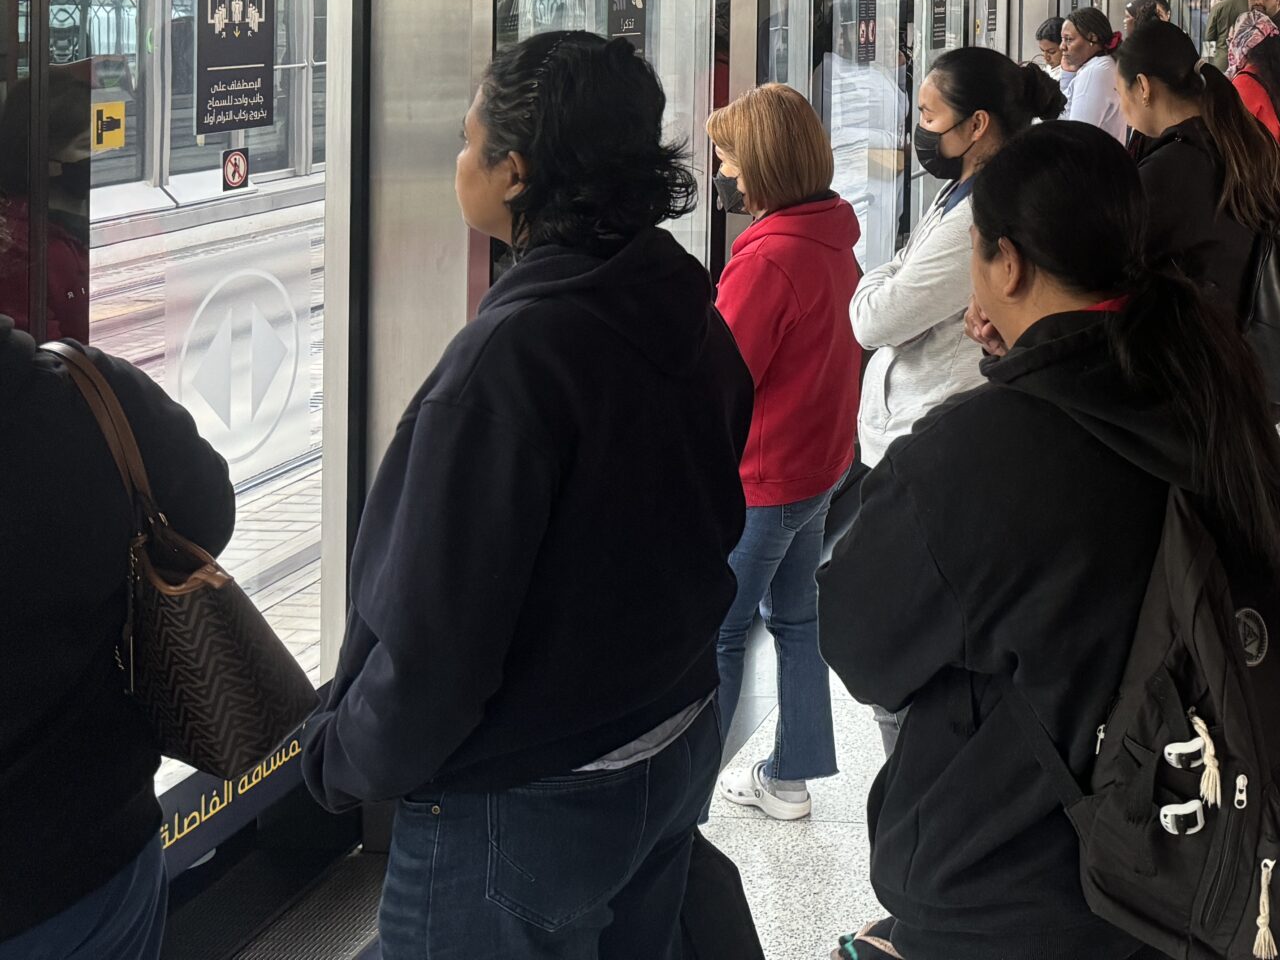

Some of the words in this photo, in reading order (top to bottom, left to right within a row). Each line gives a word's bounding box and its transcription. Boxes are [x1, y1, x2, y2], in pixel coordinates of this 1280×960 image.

[210, 81, 226, 93] على
[207, 96, 233, 110] للسماح
[234, 94, 248, 106] واحد
[249, 92, 264, 105] جانب
[216, 110, 233, 124] الترام
[234, 110, 248, 122] ركاب
[160, 780, 232, 850] الفاصلة
